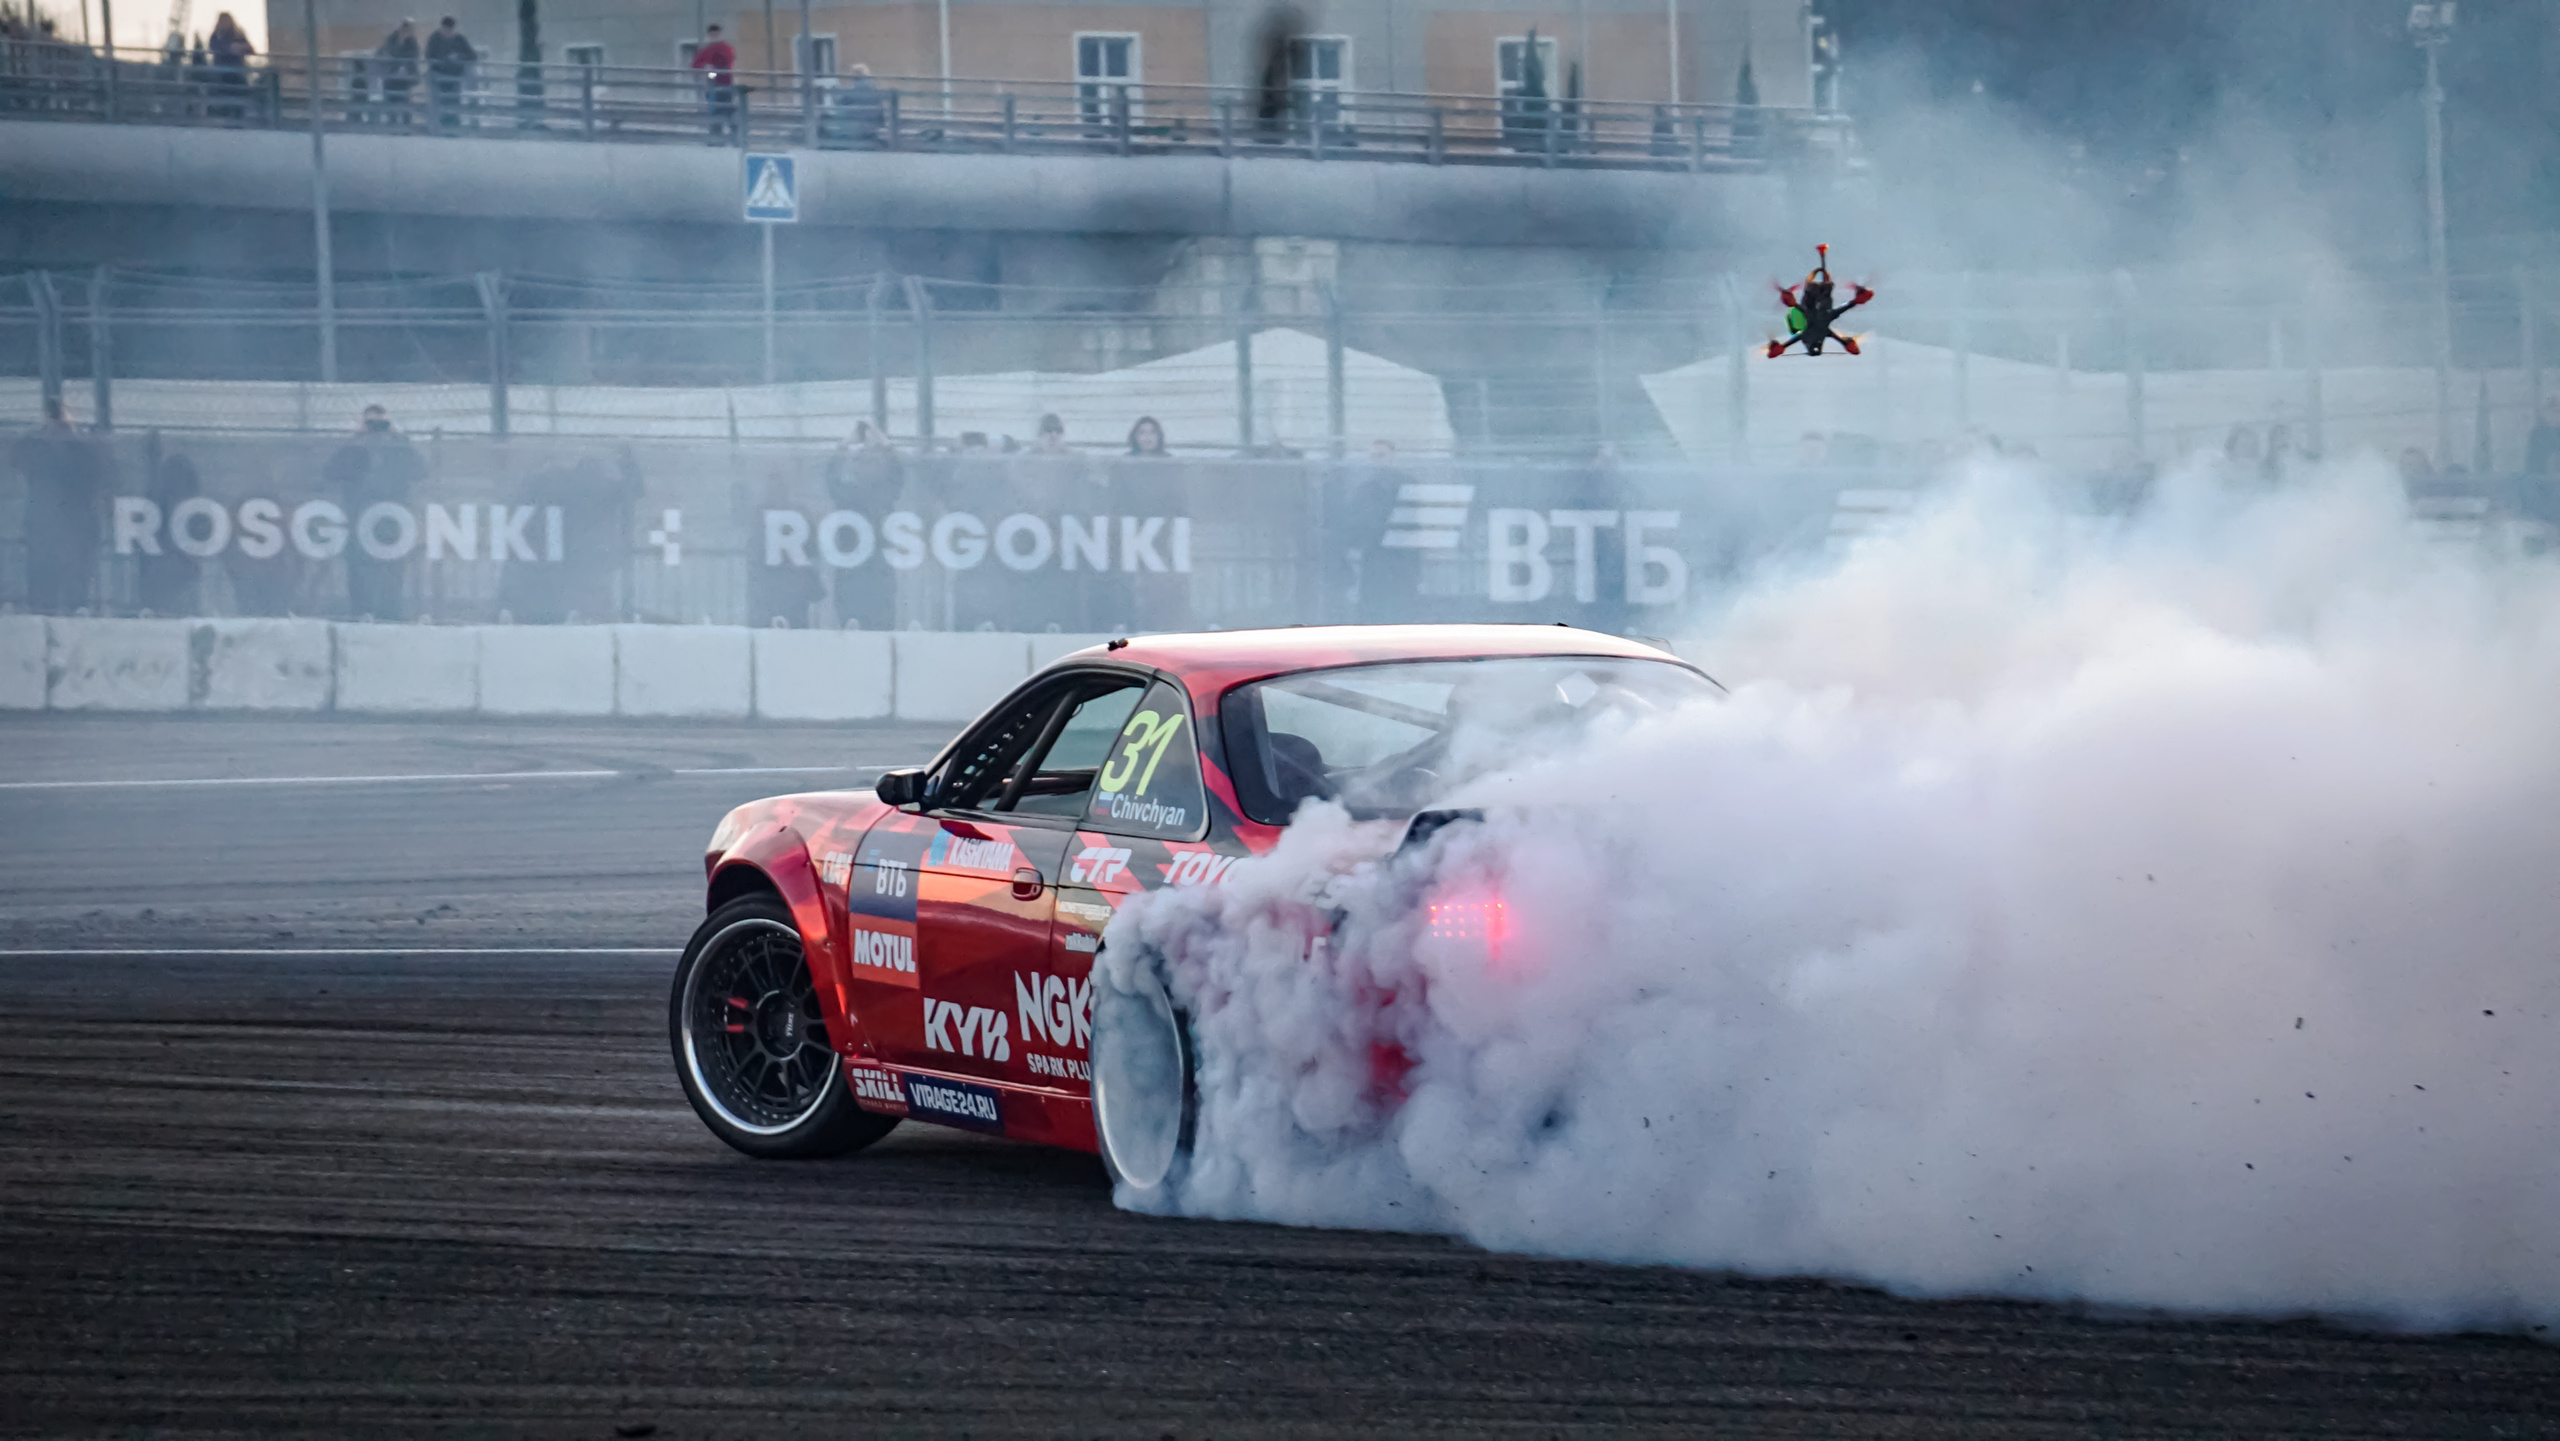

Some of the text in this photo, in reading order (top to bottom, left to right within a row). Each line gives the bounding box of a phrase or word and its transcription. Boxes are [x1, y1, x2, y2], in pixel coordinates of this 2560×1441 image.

[114, 496, 564, 562] ROSGONKI
[764, 508, 1193, 573] ROSGONKI
[1487, 507, 1688, 604] ВТБ
[1100, 710, 1185, 796] 31
[1111, 793, 1186, 830] Chivchyan
[875, 858, 908, 898] ВТБ
[853, 928, 916, 973] MOTUL
[923, 997, 1011, 1063] KYB
[1014, 969, 1092, 1050] NGK
[852, 1067, 906, 1102] SKILL
[1026, 1052, 1069, 1079] SPARK
[909, 1082, 998, 1121] VIRAGE24.RU
